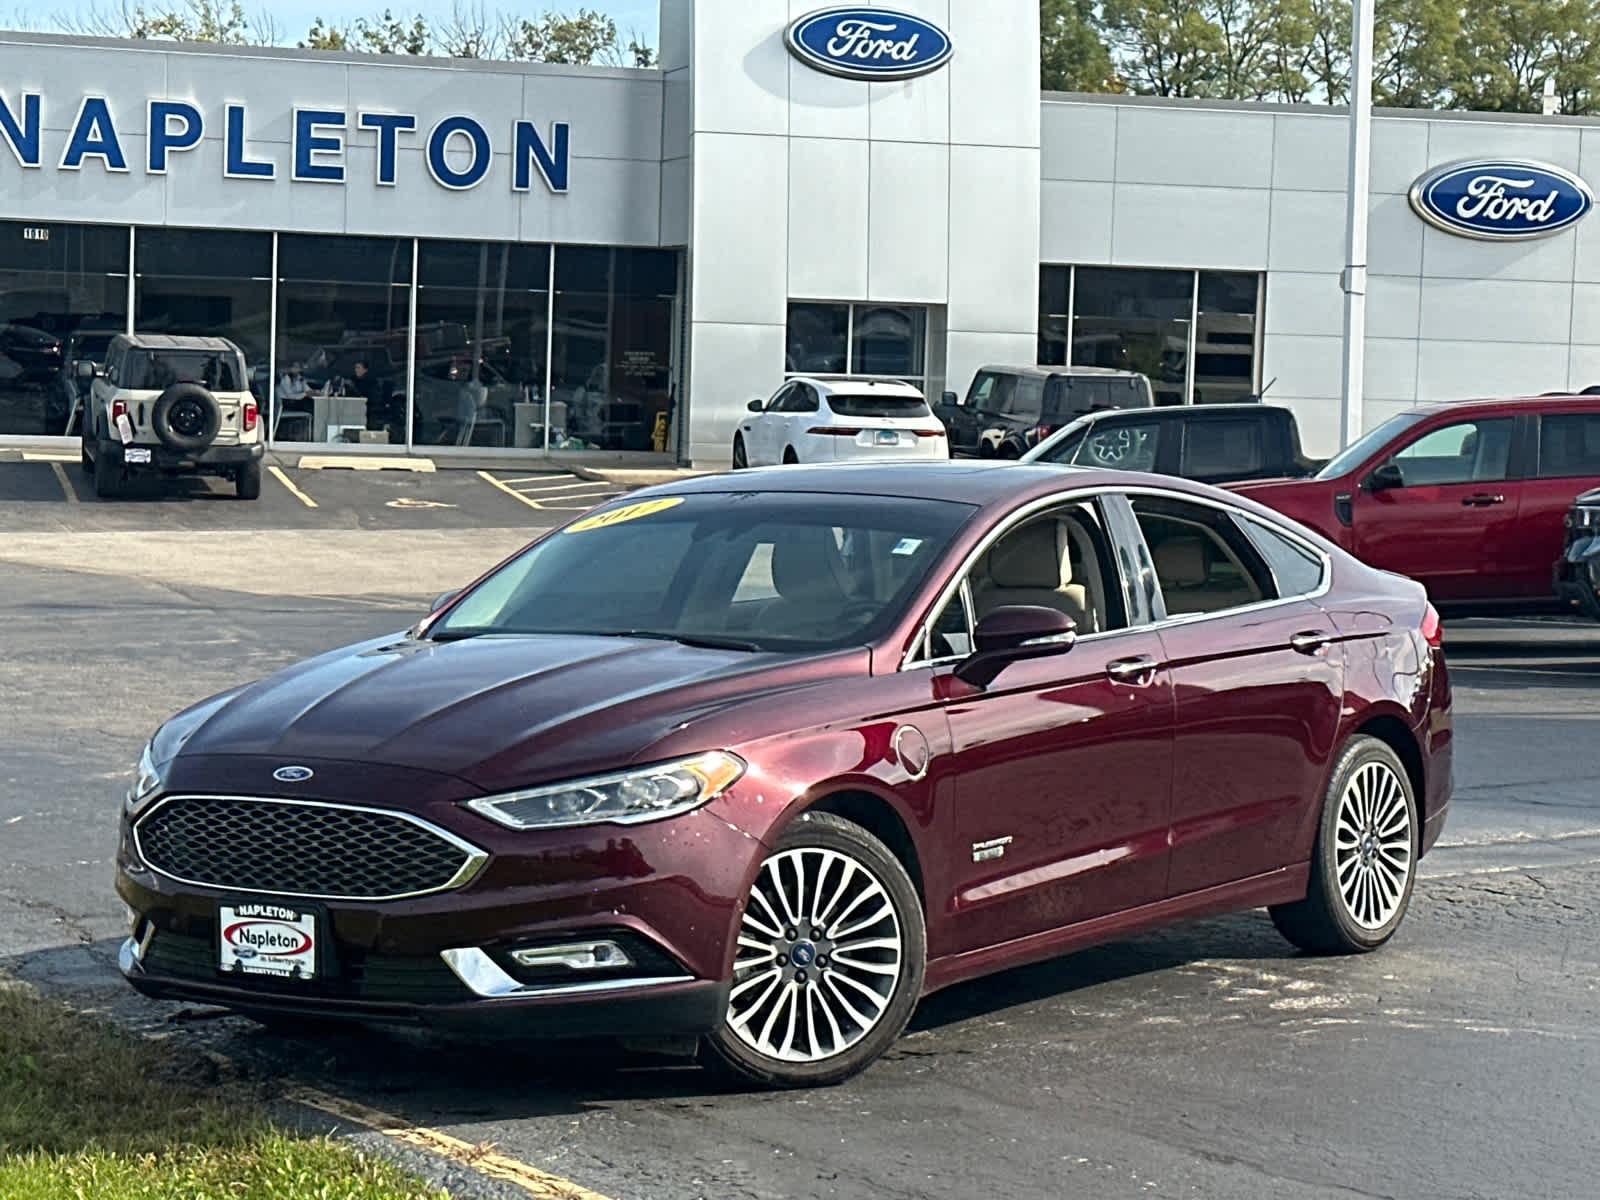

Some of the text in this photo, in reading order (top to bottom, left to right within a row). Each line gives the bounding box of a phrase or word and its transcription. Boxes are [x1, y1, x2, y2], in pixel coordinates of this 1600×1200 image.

[827, 19, 920, 61] Ford
[0, 90, 570, 194] NAPLETON
[1456, 175, 1559, 222] Ford
[239, 904, 295, 920] NAPLETON
[239, 927, 299, 949] Napleton
